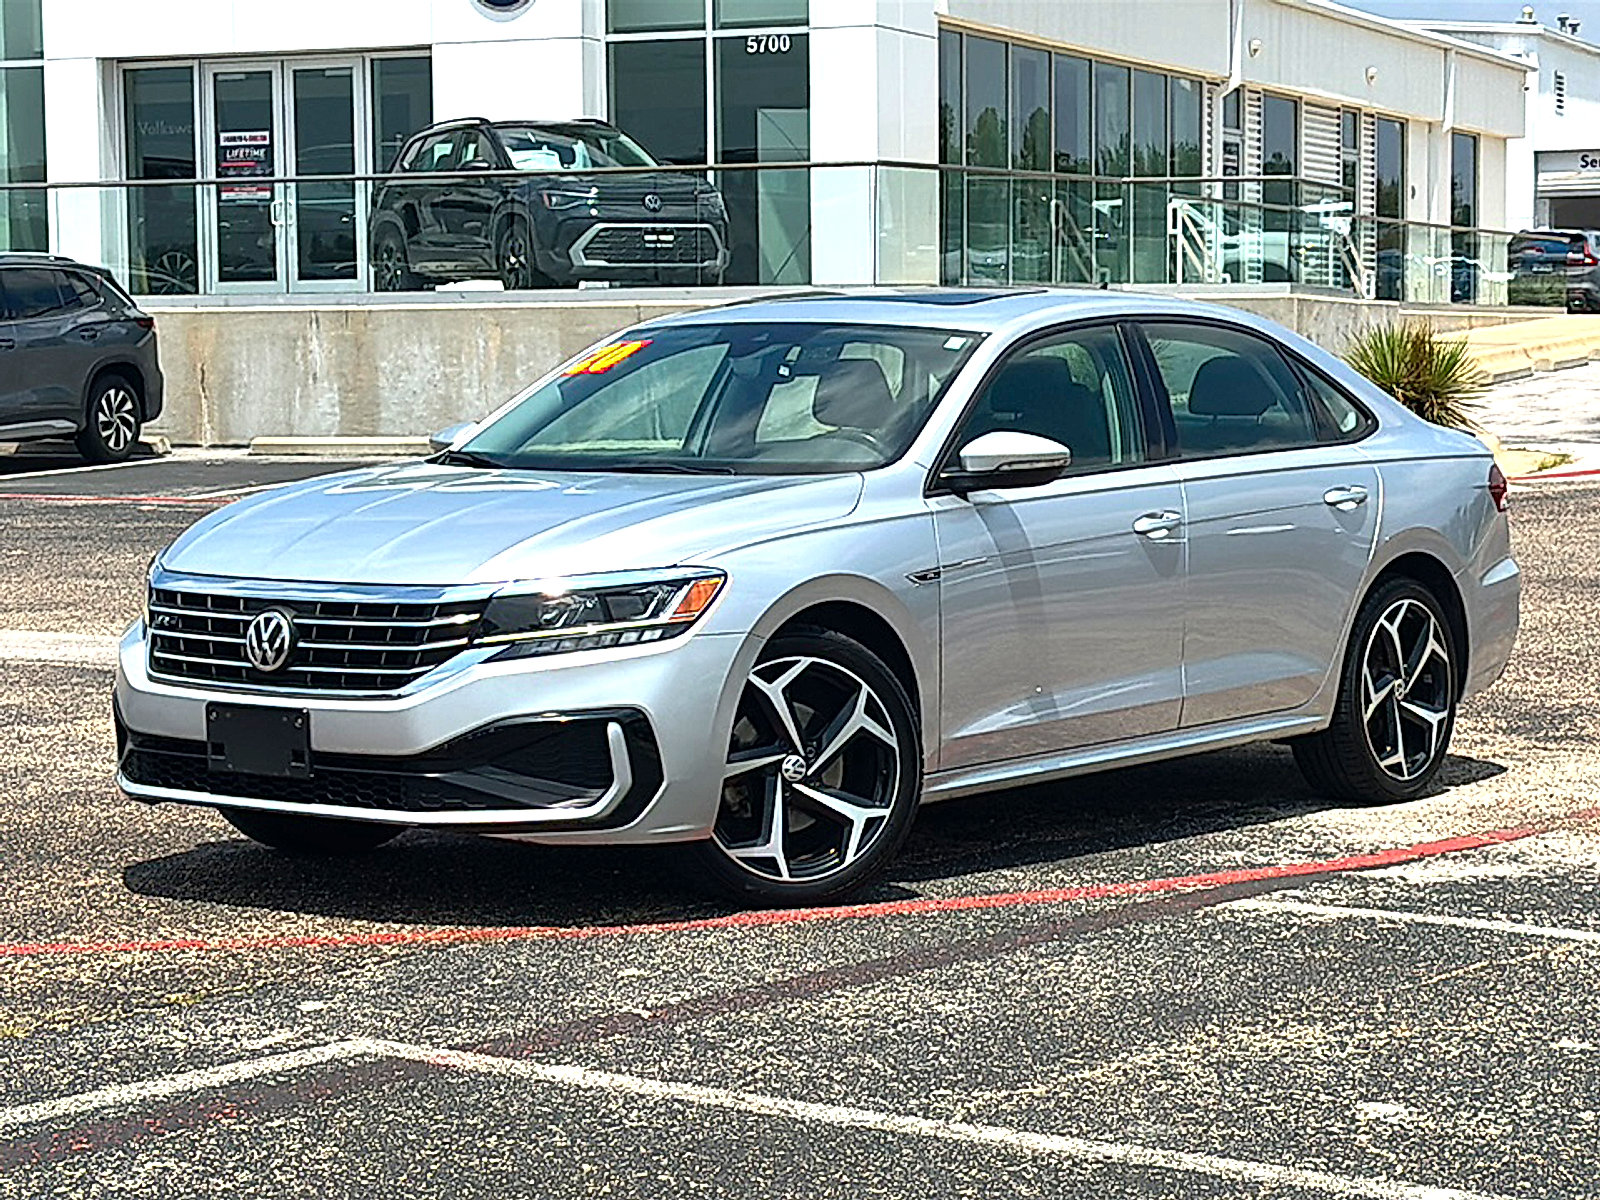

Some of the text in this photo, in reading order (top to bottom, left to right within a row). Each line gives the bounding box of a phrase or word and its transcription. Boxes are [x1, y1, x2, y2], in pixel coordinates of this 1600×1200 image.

[746, 34, 791, 53] 5700
[1580, 153, 1600, 169] Se
[247, 611, 291, 672] VW
